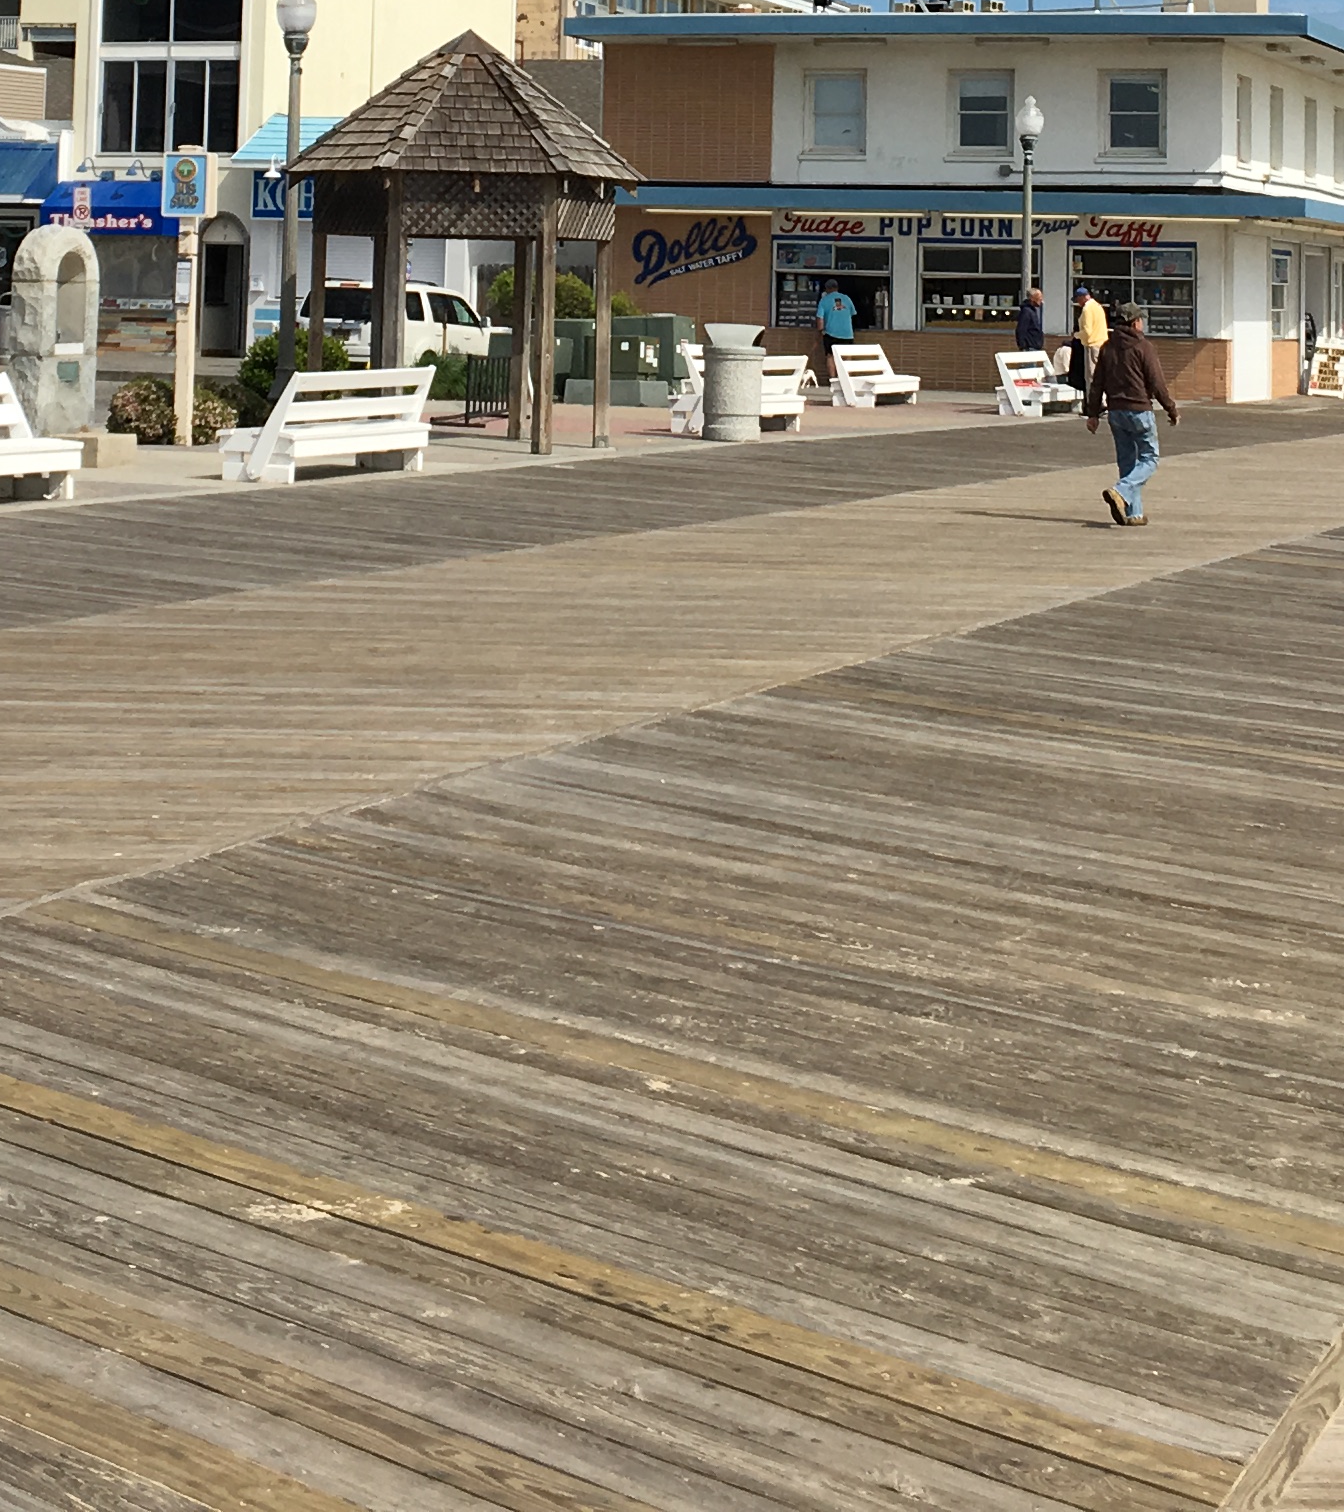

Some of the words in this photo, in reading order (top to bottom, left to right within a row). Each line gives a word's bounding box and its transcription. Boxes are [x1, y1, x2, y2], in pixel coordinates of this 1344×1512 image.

[779, 211, 865, 241] Fudge
[880, 217, 932, 236] POP
[941, 218, 1013, 237] CORN
[1084, 216, 1163, 248] Taffy
[669, 265, 687, 276] SALT
[688, 258, 715, 272] WATER
[715, 249, 744, 266] TAFFY
